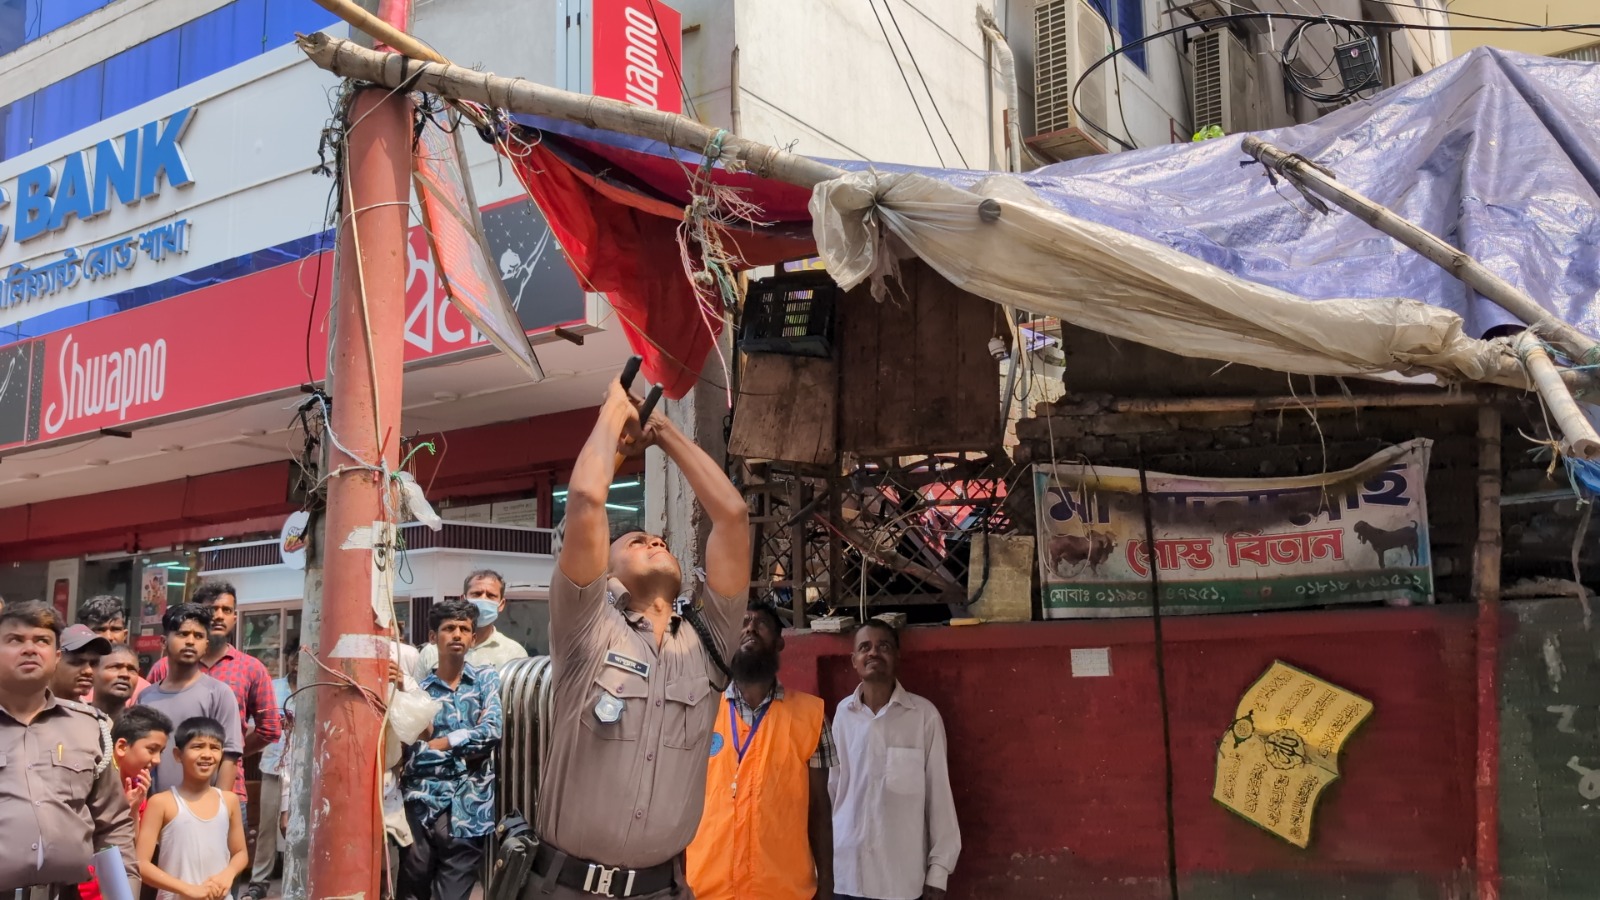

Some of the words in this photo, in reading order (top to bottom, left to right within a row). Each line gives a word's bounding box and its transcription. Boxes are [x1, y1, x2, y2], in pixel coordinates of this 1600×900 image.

[14, 106, 196, 243] BANK
[0, 247, 82, 308] লিফ্যান্ট
[83, 236, 136, 281] রোড
[139, 218, 191, 262] শাখা
[45, 333, 167, 434] Shwapno
[1222, 528, 1345, 568] বিতান
[1050, 587, 1090, 603] মোবাঃ
